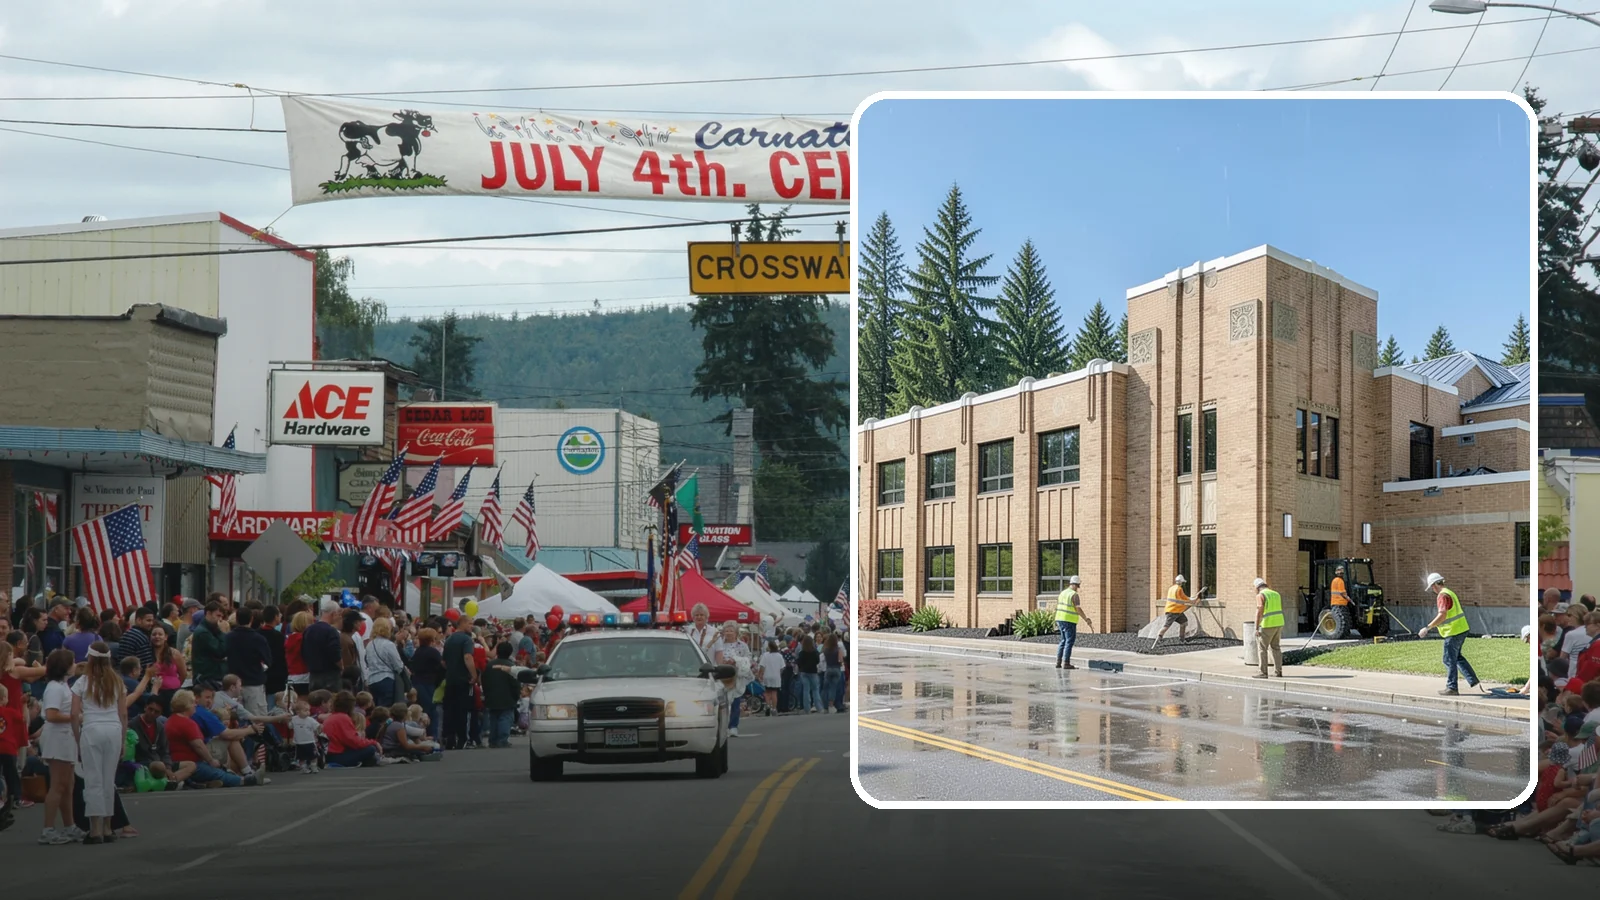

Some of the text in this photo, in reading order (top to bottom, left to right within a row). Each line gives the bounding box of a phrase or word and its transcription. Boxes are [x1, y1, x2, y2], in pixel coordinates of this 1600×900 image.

[481, 140, 605, 193] JULY
[632, 149, 746, 198] 4th.
[697, 253, 850, 280] CROSSWA
[282, 379, 373, 420] ACE
[405, 409, 485, 422] CEDAR LOG
[283, 420, 371, 436] Hardware
[83, 484, 155, 495] St. Vincent de Paul
[212, 516, 331, 536] HARDARE
[688, 526, 741, 535] CRNATION
[699, 535, 730, 543] GLASS
